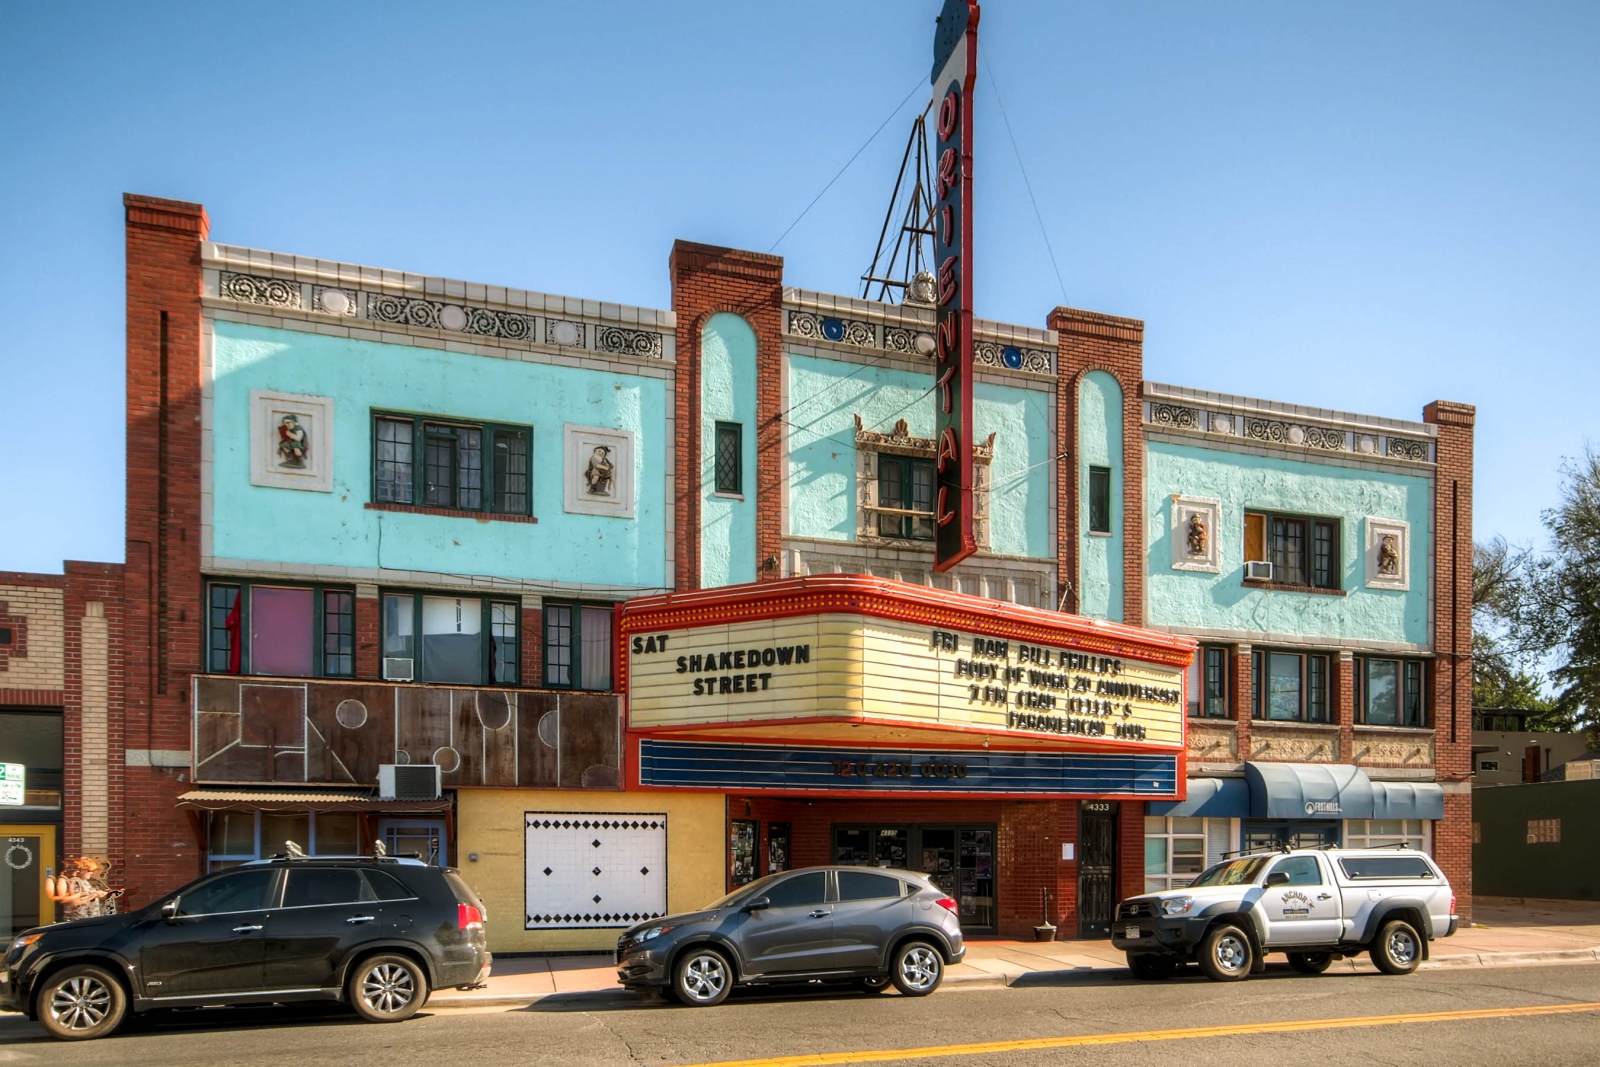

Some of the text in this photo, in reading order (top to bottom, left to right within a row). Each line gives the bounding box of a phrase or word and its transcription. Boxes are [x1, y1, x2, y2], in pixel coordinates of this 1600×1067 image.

[937, 91, 958, 528] ORIENTAL
[632, 634, 669, 654] SAT
[933, 630, 959, 652] FRI
[1060, 651, 1122, 675] PHILLIPS
[676, 644, 810, 674] SHAKEDOWN
[693, 672, 772, 696] STREET
[956, 658, 1180, 704] BODY OF WORK 20 ANNIVERSARY
[1017, 690, 1057, 710] CHAD
[1115, 722, 1147, 741] TOUR
[831, 760, 867, 777] 720
[921, 761, 967, 779] 0030
[1087, 803, 1110, 811] 4333
[1314, 801, 1339, 812] FOOTHILLS
[1281, 890, 1308, 904] ANCHOR
